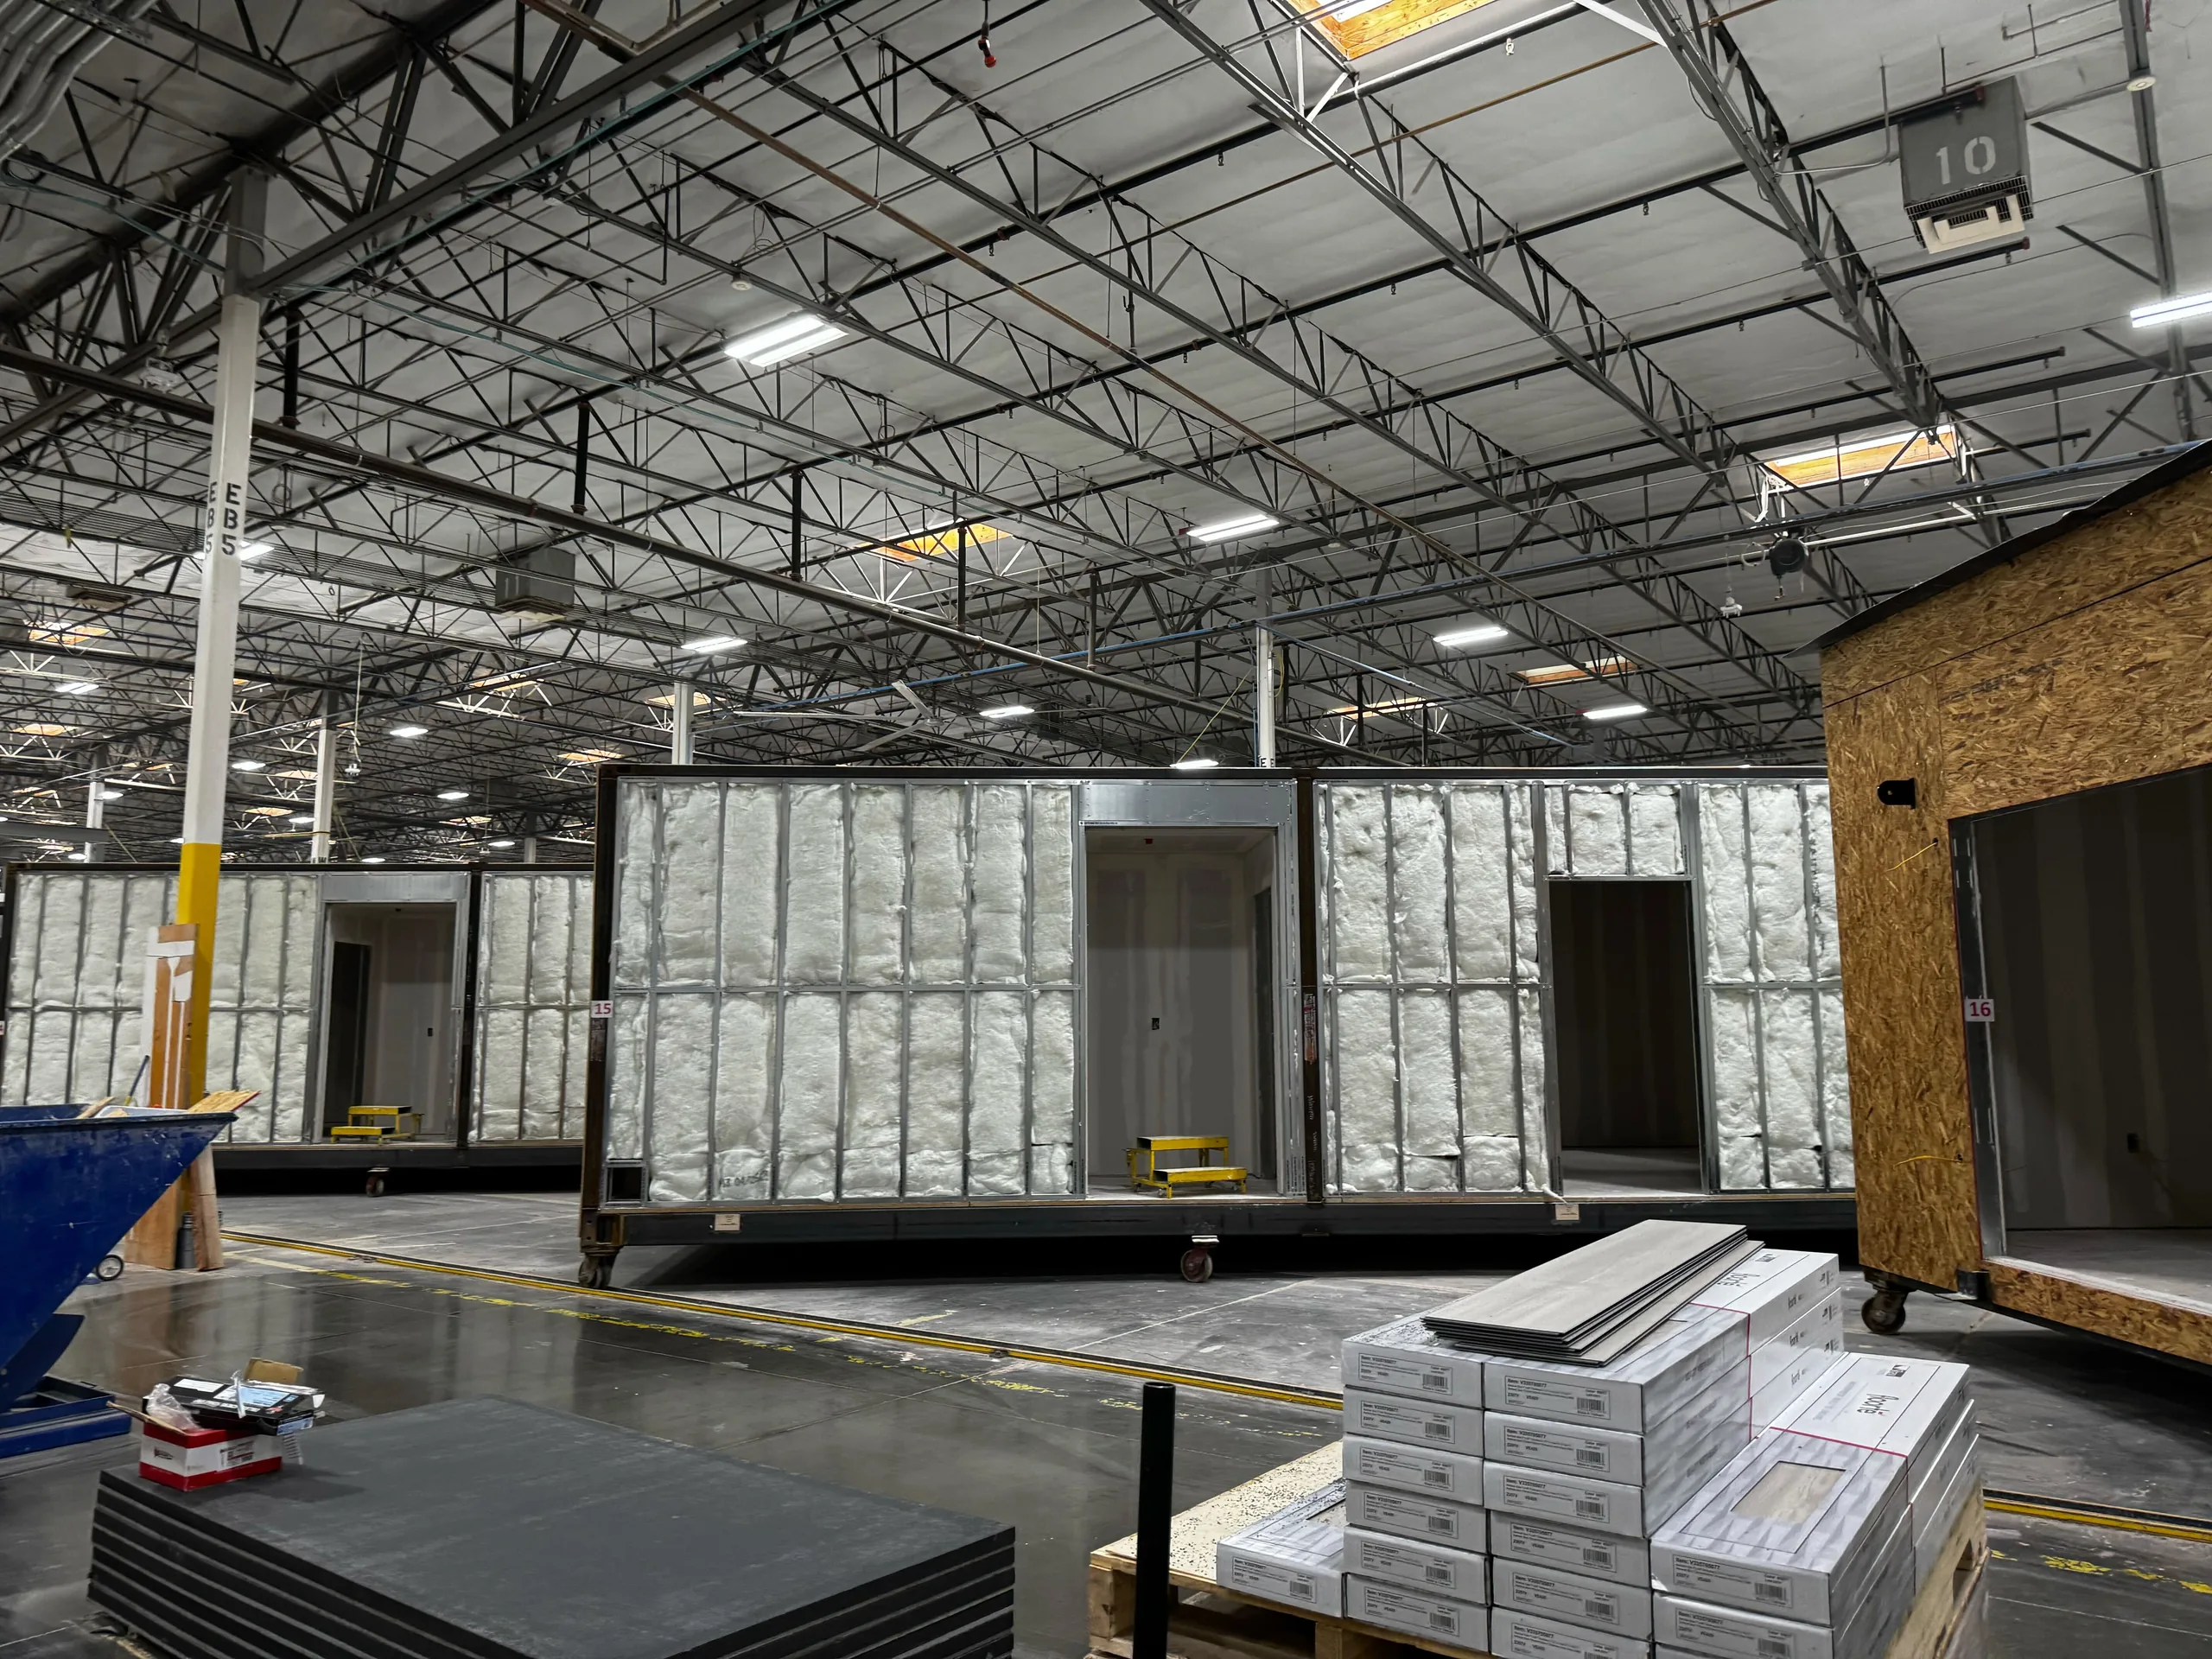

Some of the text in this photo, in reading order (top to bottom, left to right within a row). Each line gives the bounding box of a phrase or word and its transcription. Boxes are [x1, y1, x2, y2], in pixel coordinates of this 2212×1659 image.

[1936, 136, 1996, 185] 10
[594, 1003, 612, 1014] 15
[1969, 1001, 1991, 1017] 16
